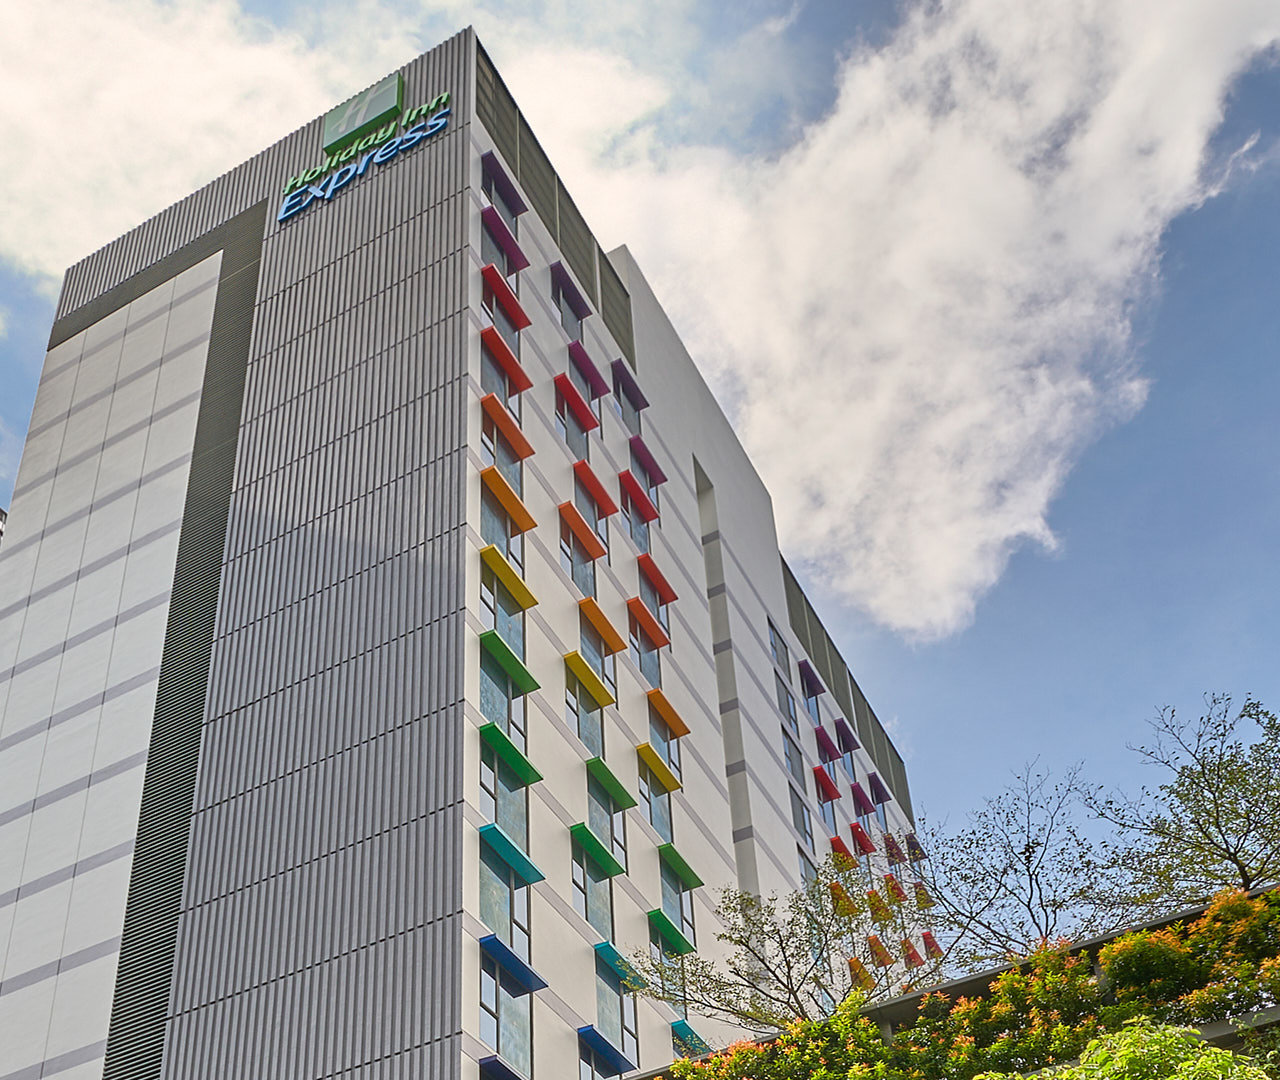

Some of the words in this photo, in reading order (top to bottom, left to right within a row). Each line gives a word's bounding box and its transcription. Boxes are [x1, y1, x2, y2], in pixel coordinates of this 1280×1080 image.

[277, 108, 451, 223] Express
[282, 121, 397, 195] Holiday
[401, 92, 450, 128] Inn
